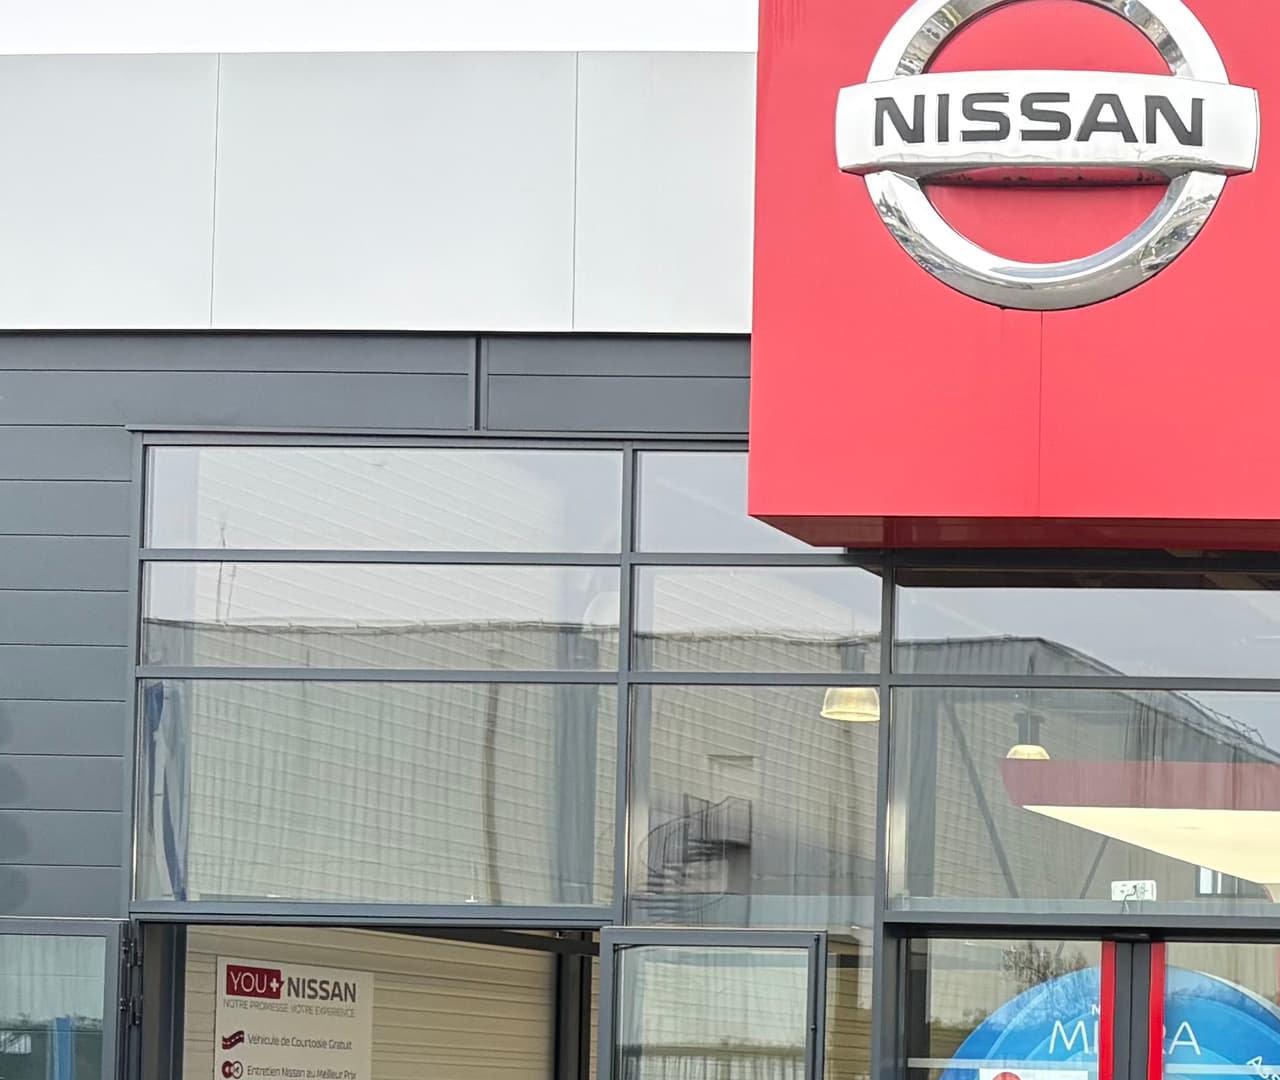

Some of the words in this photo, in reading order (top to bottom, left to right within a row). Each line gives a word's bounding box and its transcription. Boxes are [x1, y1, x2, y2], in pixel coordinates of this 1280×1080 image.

[874, 92, 1204, 147] NISSAN
[287, 976, 357, 1003] NISSAN
[223, 999, 248, 1010] NOTRE
[280, 1037, 291, 1047] de
[291, 1037, 327, 1050] Courtoisie
[329, 1040, 353, 1050] Gratuit
[247, 1066, 280, 1077] Entretien
[282, 1067, 305, 1078] Nissan
[306, 1070, 316, 1079] au
[317, 1069, 343, 1080] Meilleur
[344, 1070, 356, 1080] Prix
